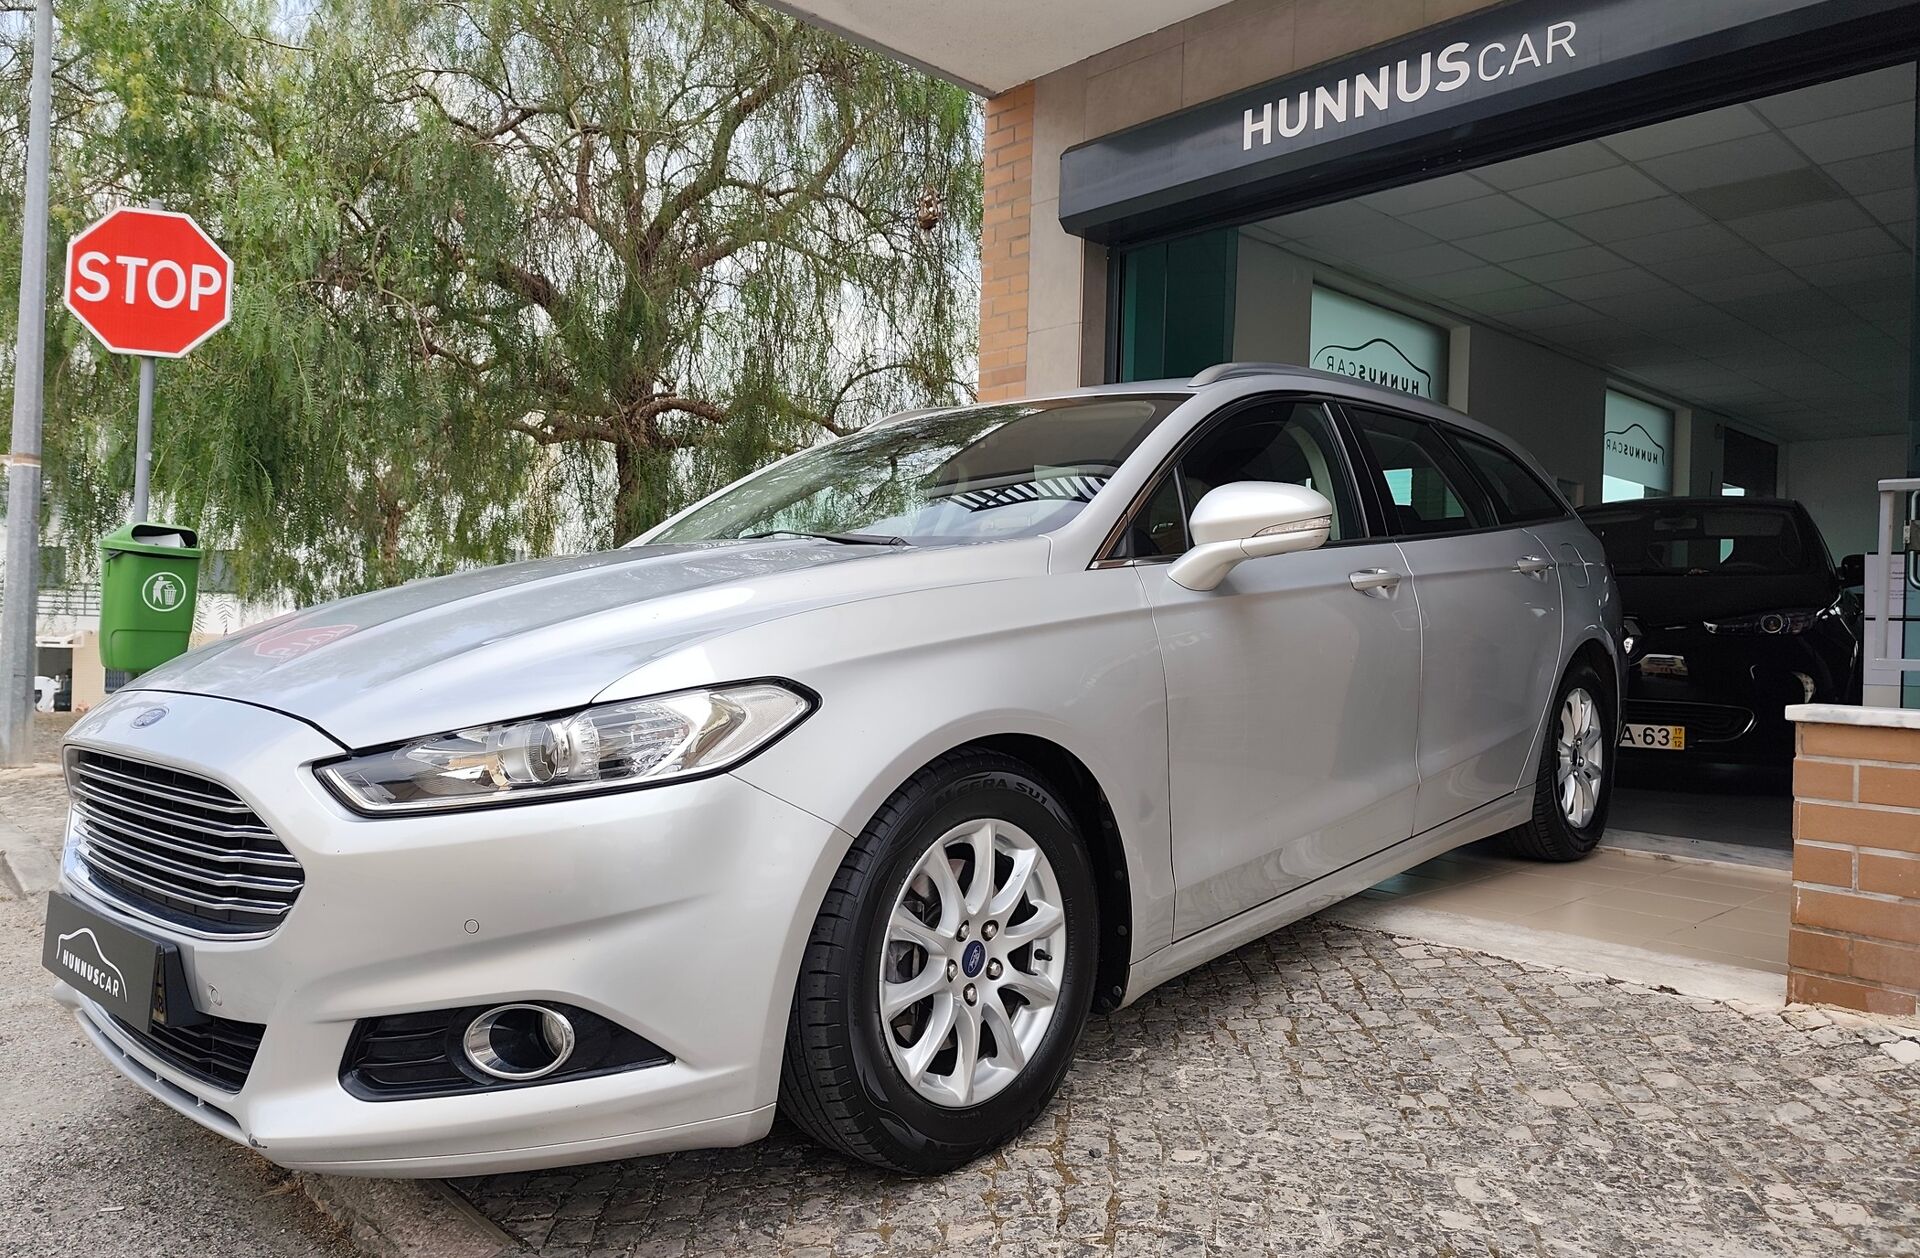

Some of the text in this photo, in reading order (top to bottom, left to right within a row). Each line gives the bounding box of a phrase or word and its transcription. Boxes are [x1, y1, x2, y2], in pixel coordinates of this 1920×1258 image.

[1243, 20, 1577, 151] HUNNUSCAR
[75, 251, 222, 311] STOP
[62, 949, 120, 998] HUNNUSCAR
